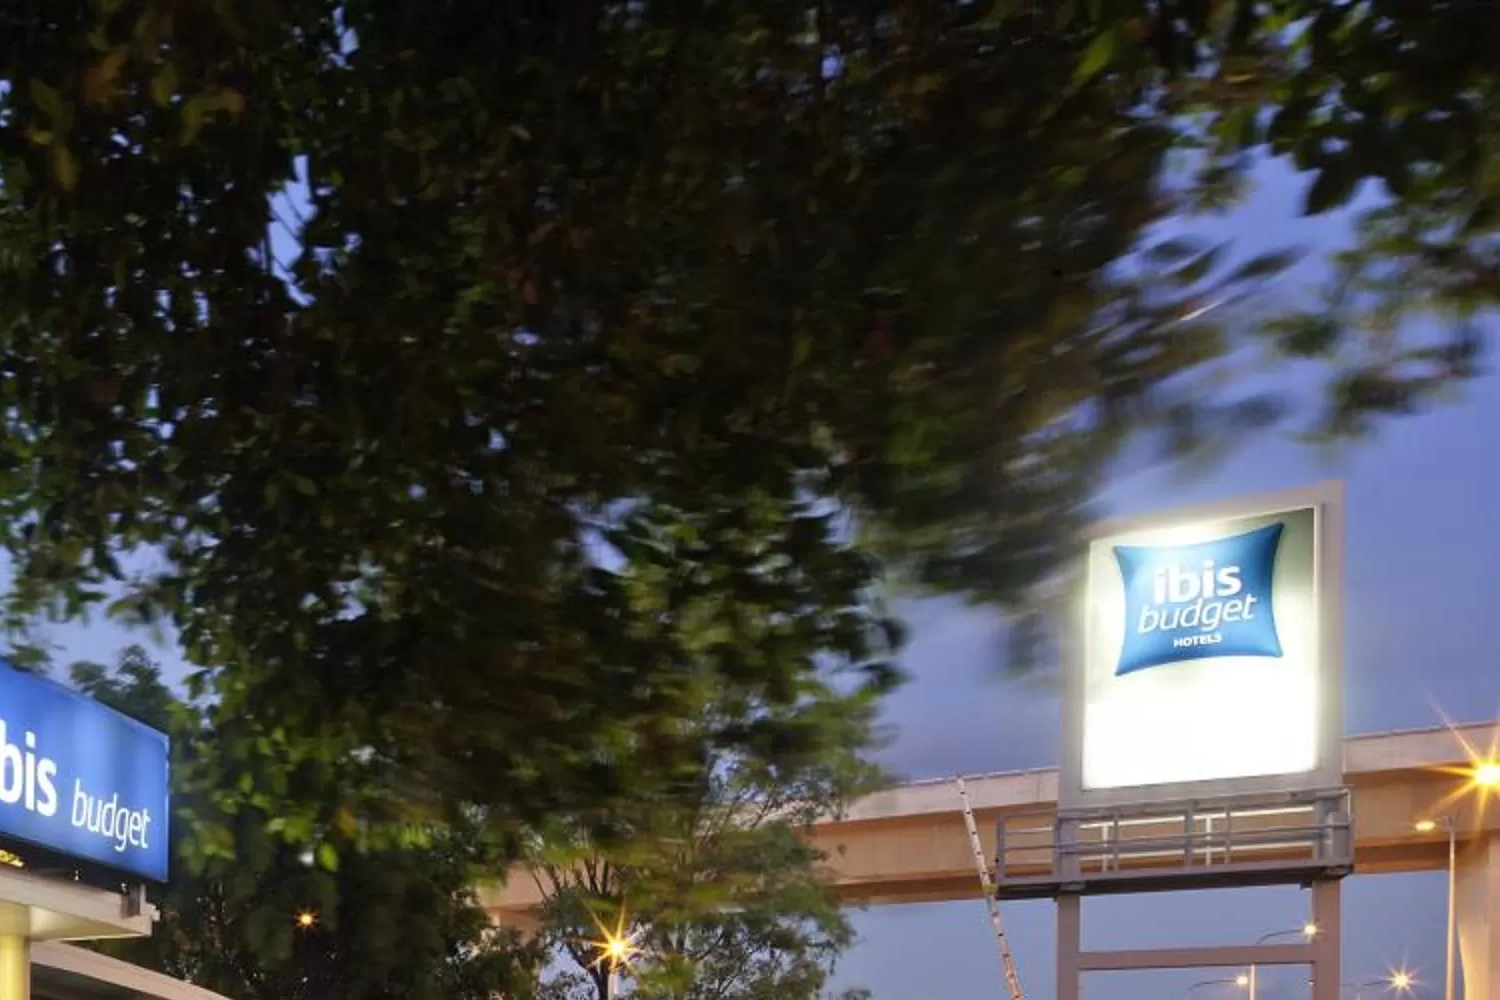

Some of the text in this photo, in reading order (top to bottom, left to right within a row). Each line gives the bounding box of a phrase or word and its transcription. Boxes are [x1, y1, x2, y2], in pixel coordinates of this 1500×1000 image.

[1152, 559, 1242, 605] ibis
[1137, 593, 1257, 634] budget
[1173, 632, 1223, 648] HOTELS
[71, 778, 151, 851] budget
